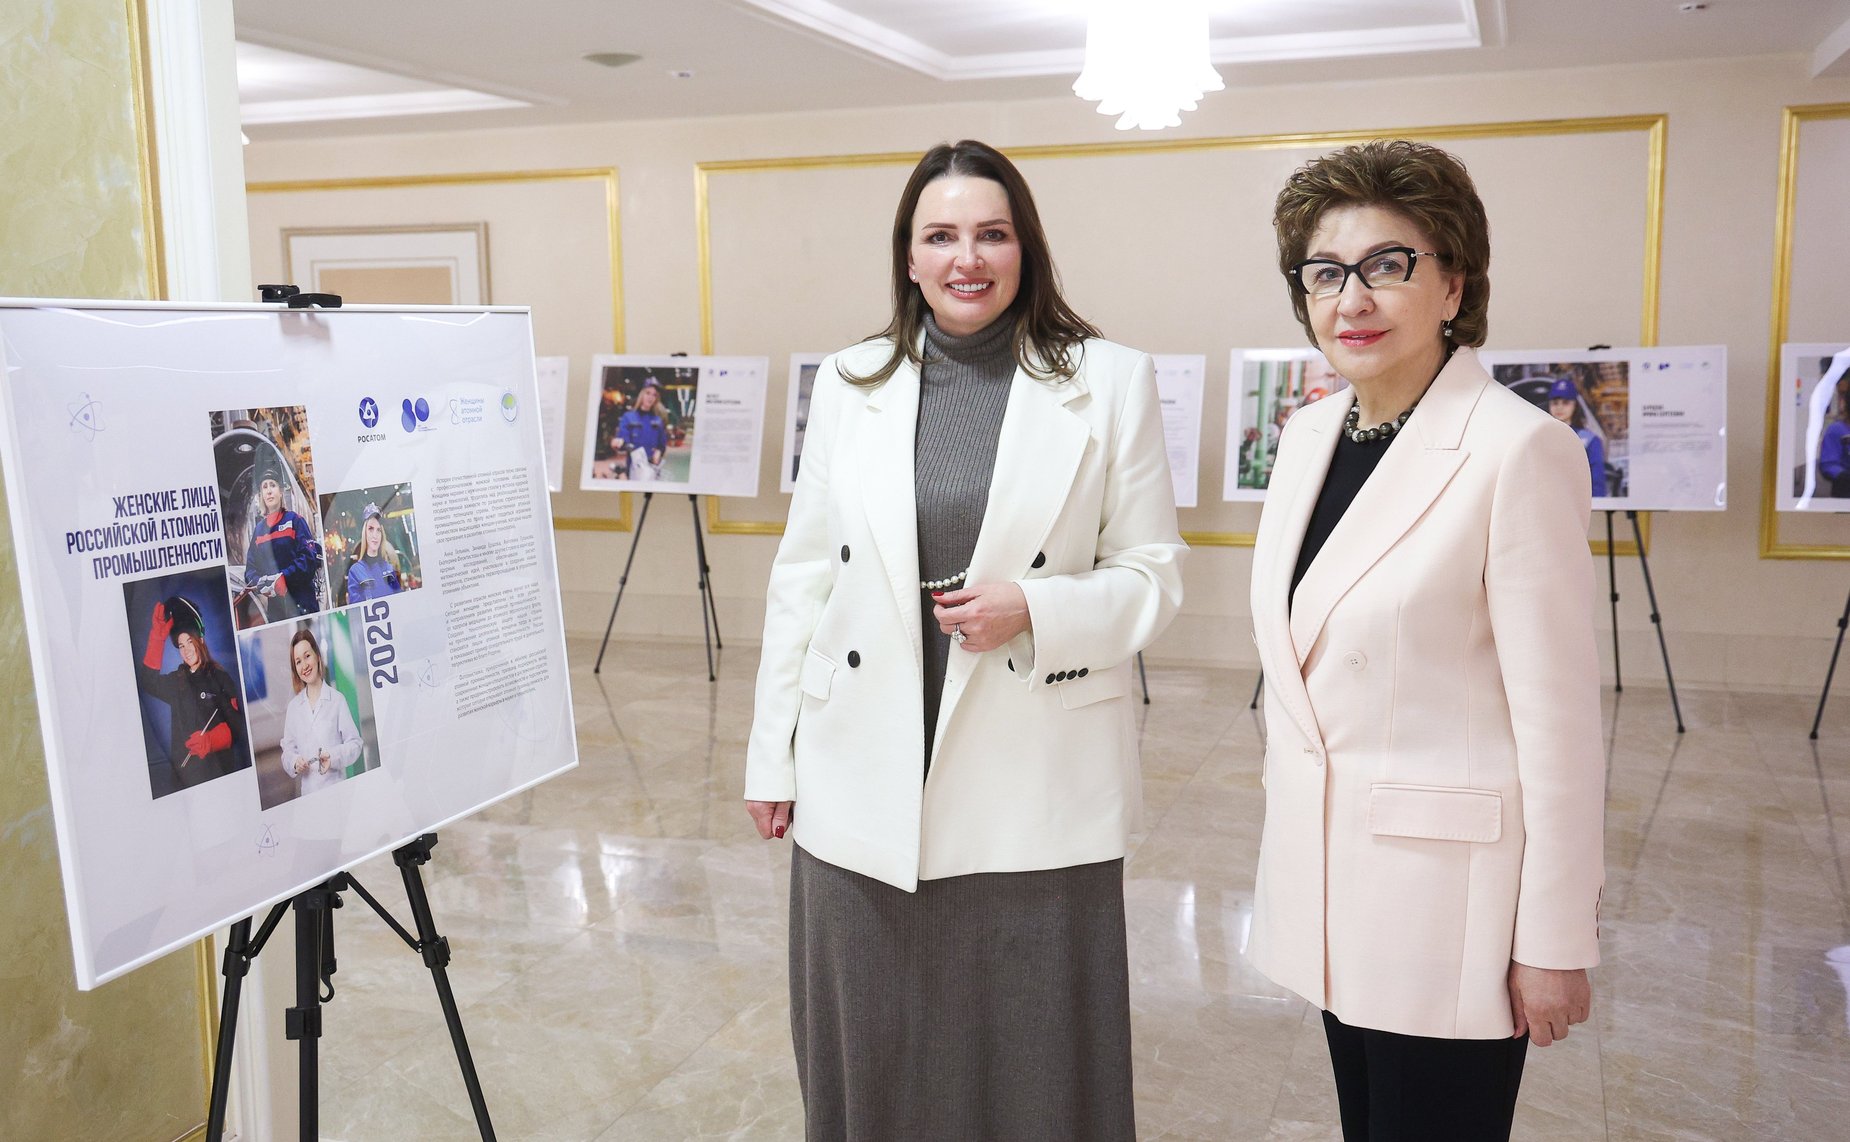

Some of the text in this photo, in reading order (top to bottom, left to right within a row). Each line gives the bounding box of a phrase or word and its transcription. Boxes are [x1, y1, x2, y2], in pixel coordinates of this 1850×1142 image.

[357, 433, 386, 443] РОСАТОМ
[113, 486, 217, 518] ЖЕНСКИЕ ЛИЦА
[66, 509, 220, 554] РОССИЙСКОЙ АТОМНОЙ
[93, 538, 223, 580] ПРОМЫШЛЕННОСТИ
[364, 600, 399, 689] 2025
